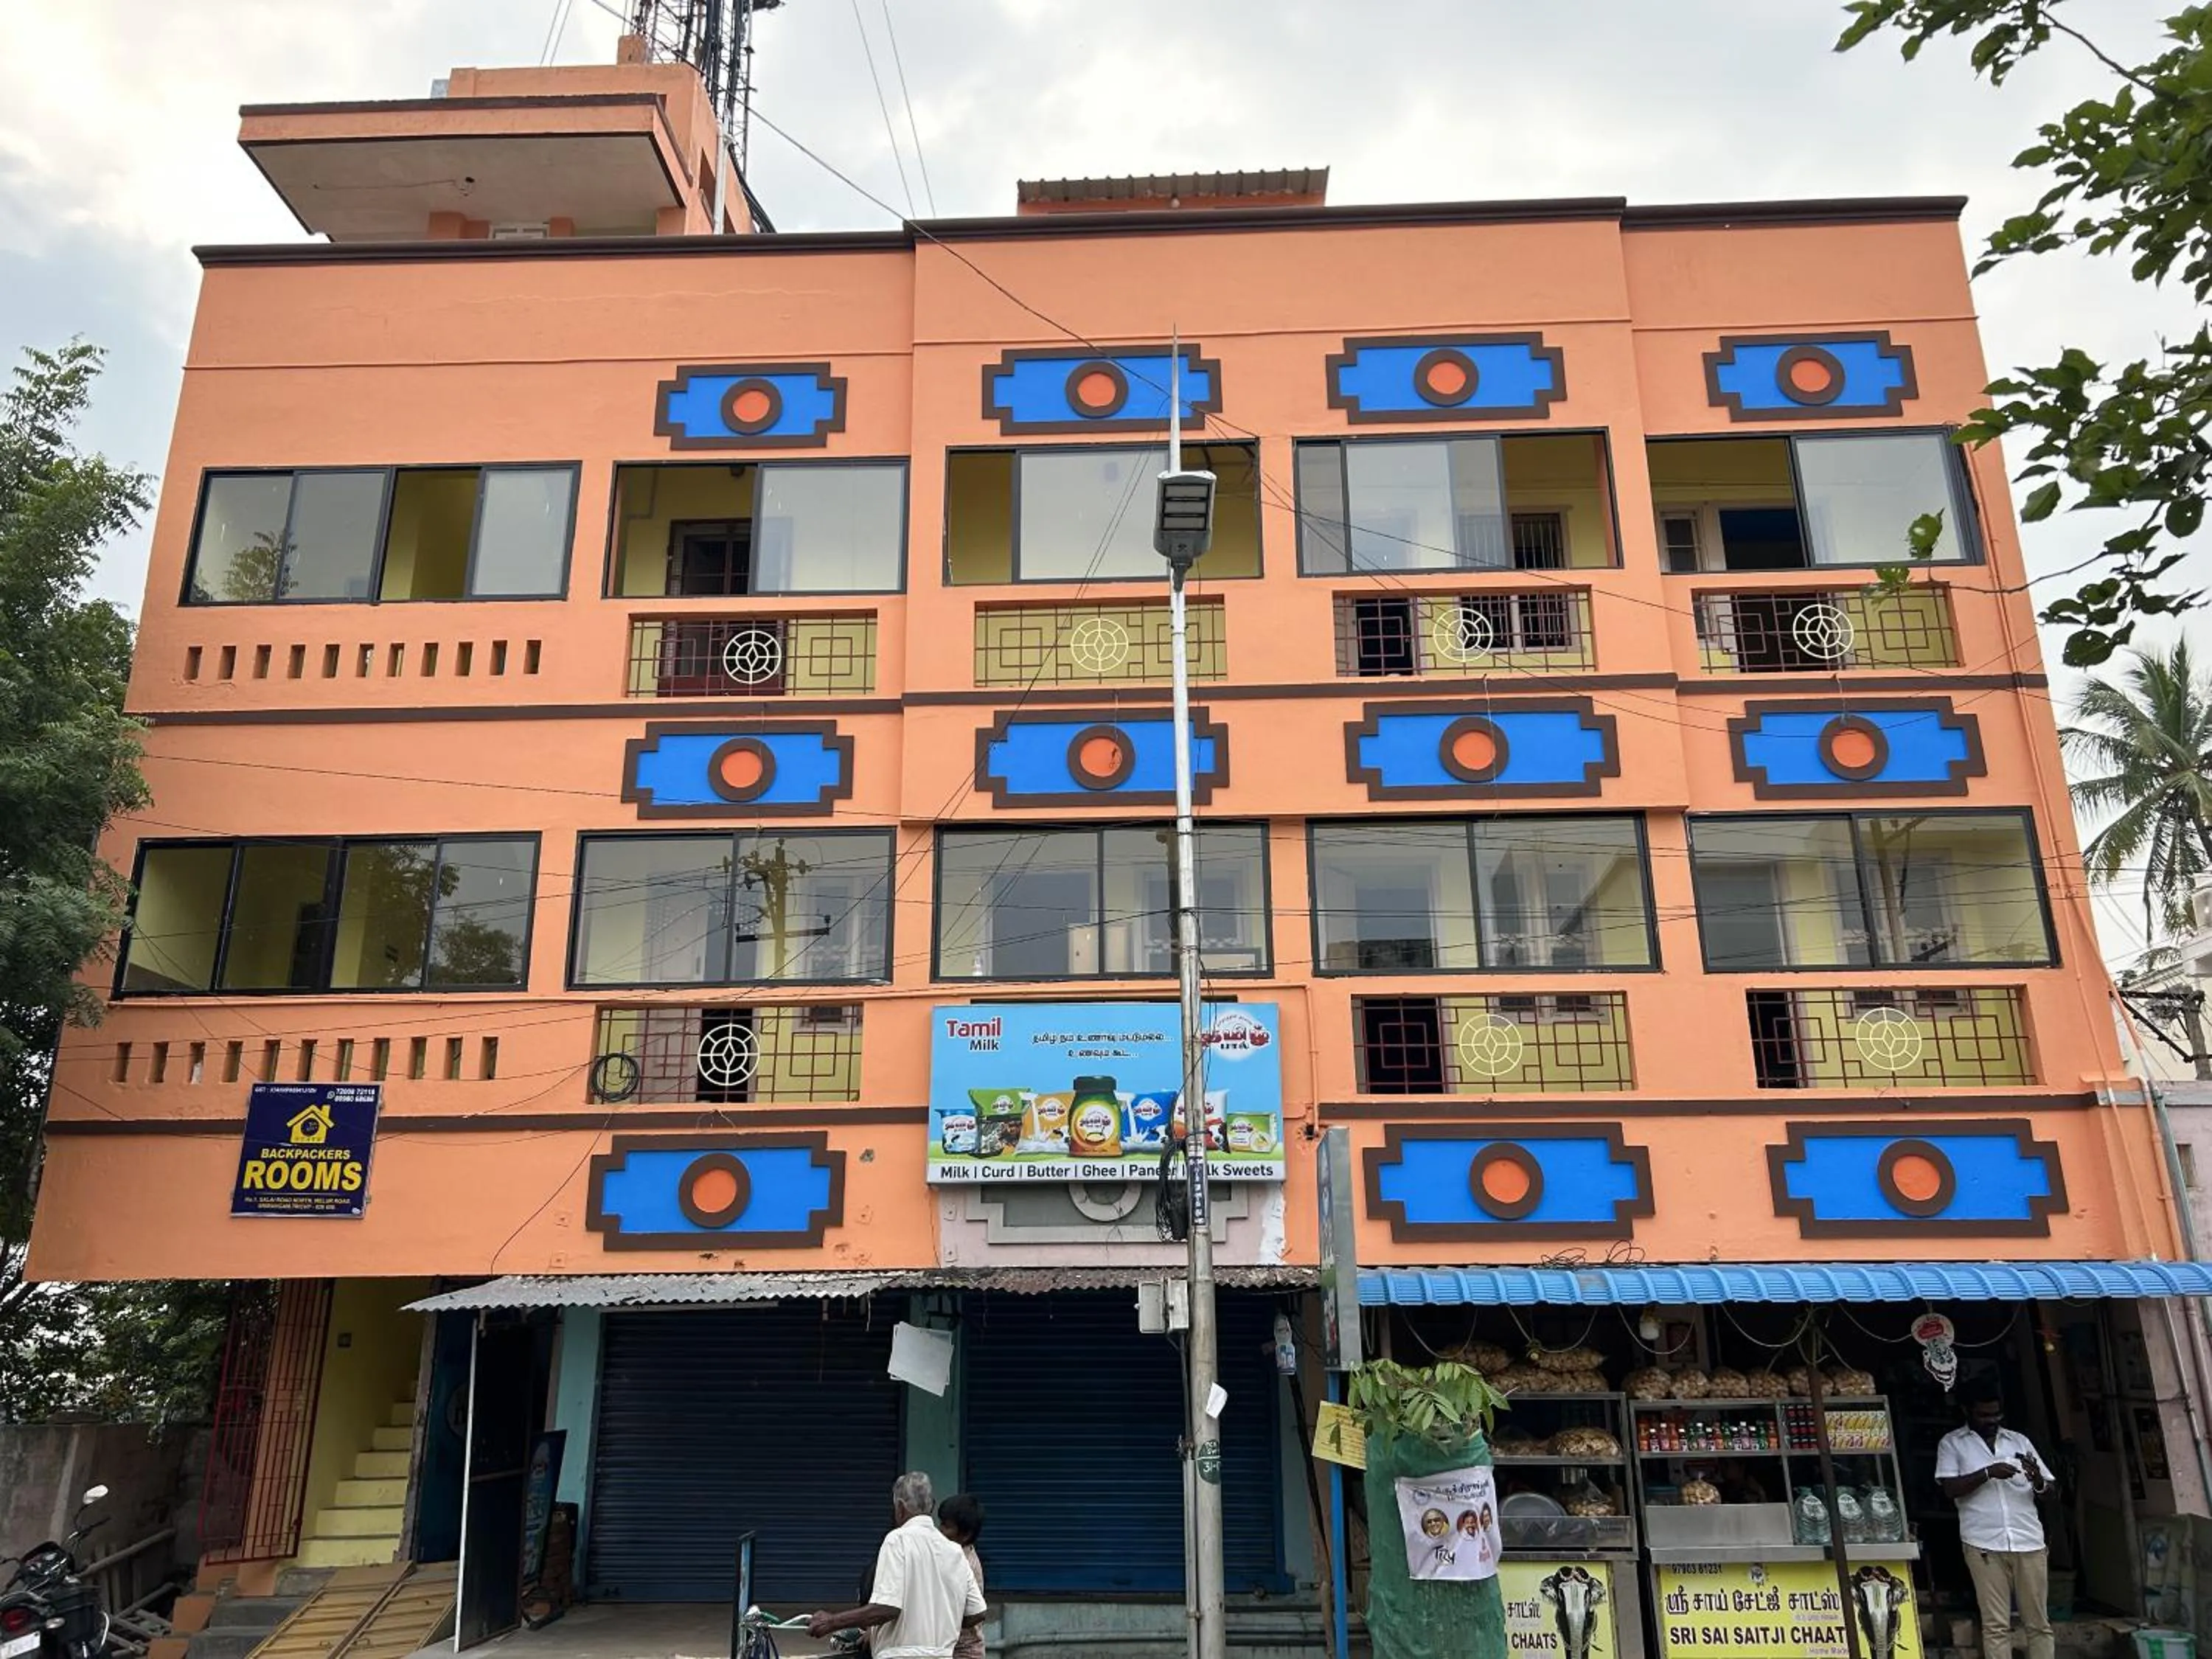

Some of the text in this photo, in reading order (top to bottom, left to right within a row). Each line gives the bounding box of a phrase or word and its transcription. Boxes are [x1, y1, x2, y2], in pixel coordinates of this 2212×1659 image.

[946, 1017, 1001, 1037] Tamil
[970, 1039, 999, 1050] Milk
[260, 1148, 351, 1160] BACKPACKERS
[243, 1160, 362, 1192] ROOMS
[941, 1166, 970, 1178] Milk
[981, 1166, 1015, 1178] Curd
[1027, 1165, 1071, 1178] Butter
[1082, 1164, 1117, 1177] Ghee
[1223, 1164, 1273, 1176] Sweets
[1507, 1597, 1541, 1618] சாட்ஸ்
[1693, 1588, 1728, 1611] சாய்
[1789, 1587, 1840, 1611] சாட்ஸ்
[1512, 1632, 1557, 1649] CHAATS
[1670, 1626, 1846, 1645] SRI SAI SAITJI CHAAT
